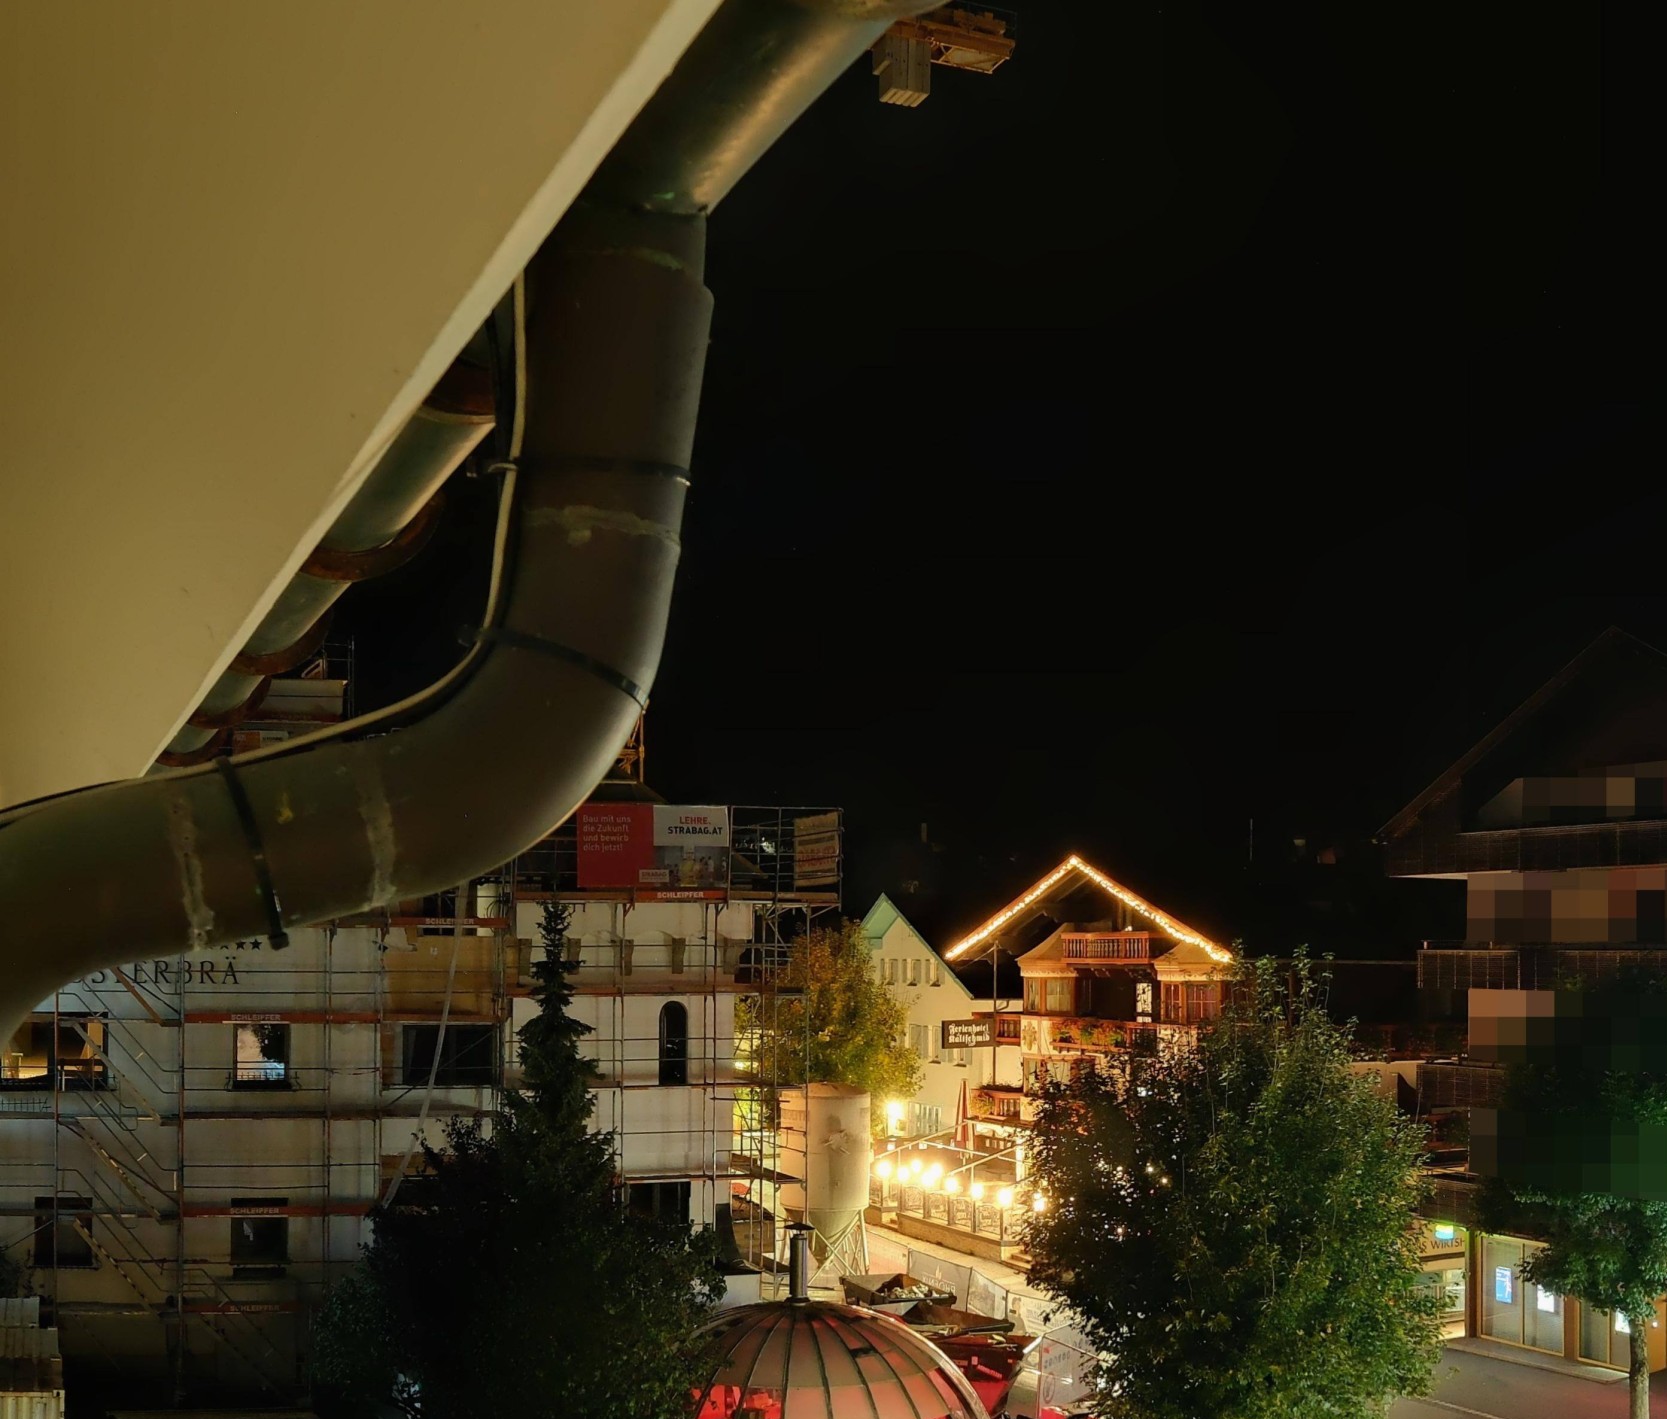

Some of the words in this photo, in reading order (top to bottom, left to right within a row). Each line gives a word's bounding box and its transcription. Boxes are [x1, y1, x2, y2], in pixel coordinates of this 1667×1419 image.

[583, 814, 600, 823] Bau
[601, 814, 616, 823] mit
[680, 816, 712, 825] LEHRE.
[583, 824, 596, 832] die
[597, 824, 630, 832] Zukunft
[668, 826, 724, 835] STRABAG.AT
[583, 833, 599, 842] und
[601, 833, 630, 842] bewirb
[583, 843, 601, 851] dich
